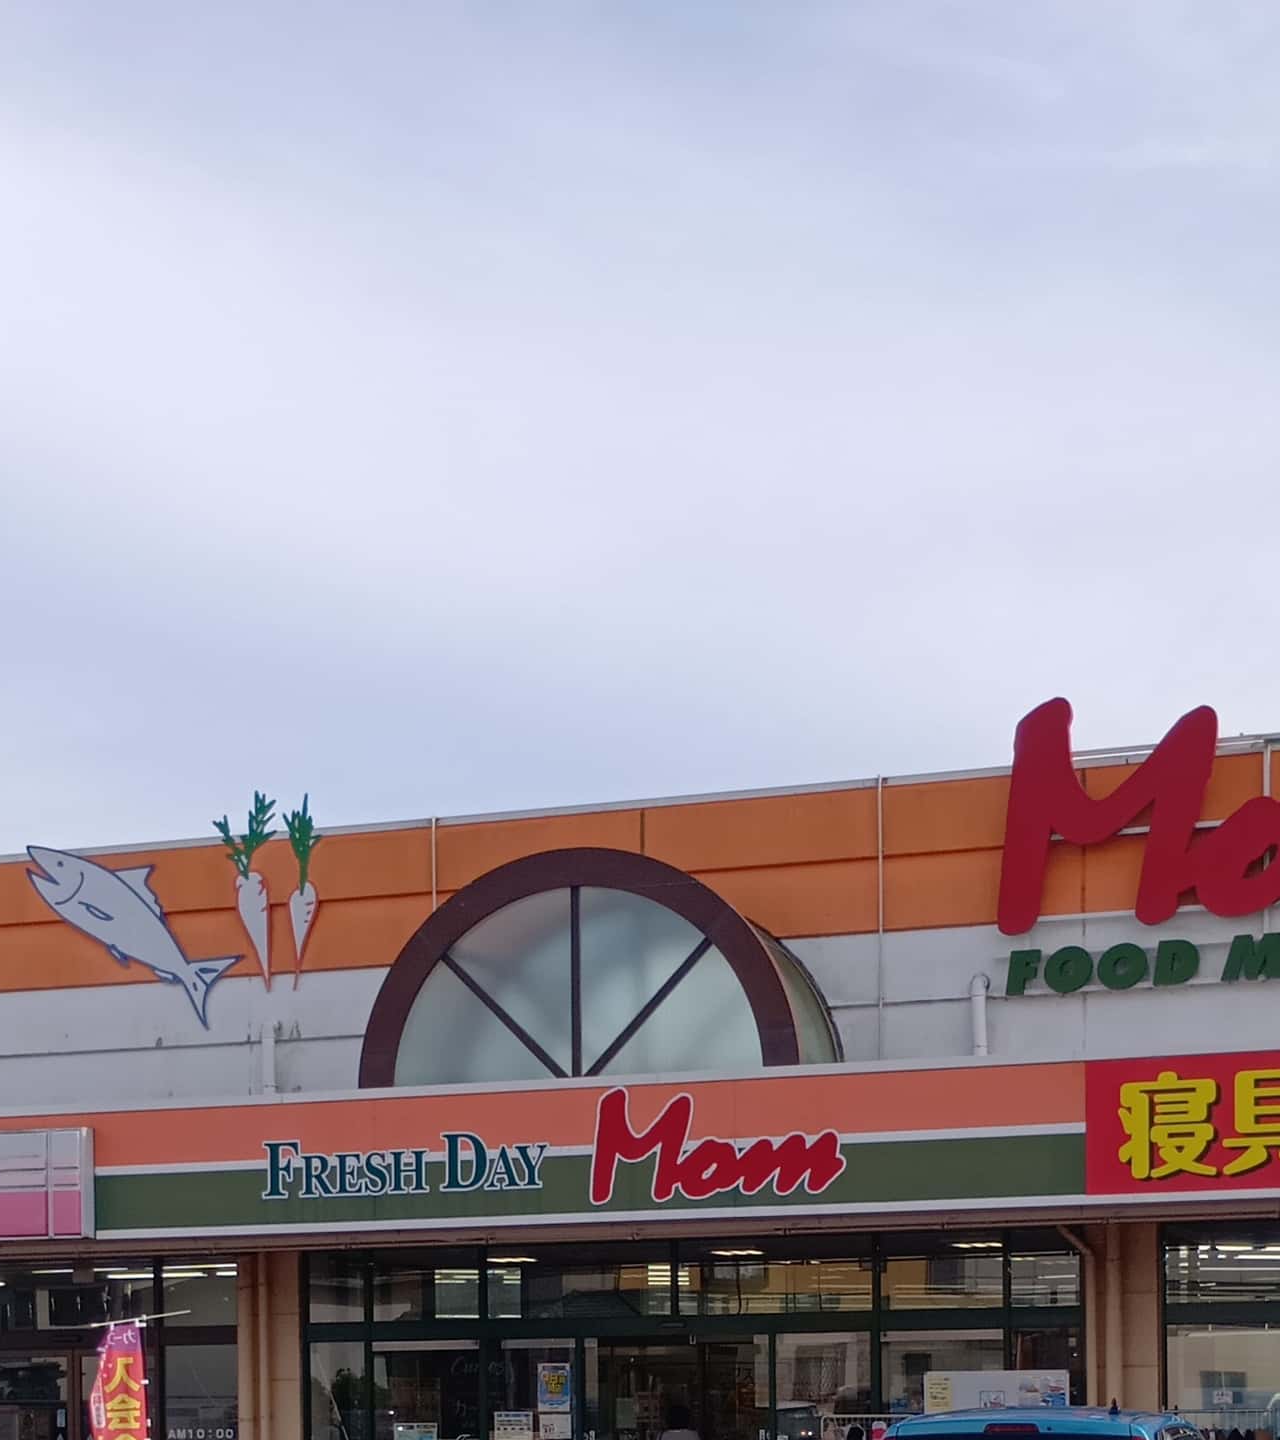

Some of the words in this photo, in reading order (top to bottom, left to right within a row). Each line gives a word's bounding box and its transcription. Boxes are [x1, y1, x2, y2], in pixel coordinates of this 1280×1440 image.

[1005, 938, 1200, 996] FOOD
[262, 1140, 429, 1199] FRESH
[440, 1132, 547, 1191] DAY
[589, 1086, 846, 1205] Mom
